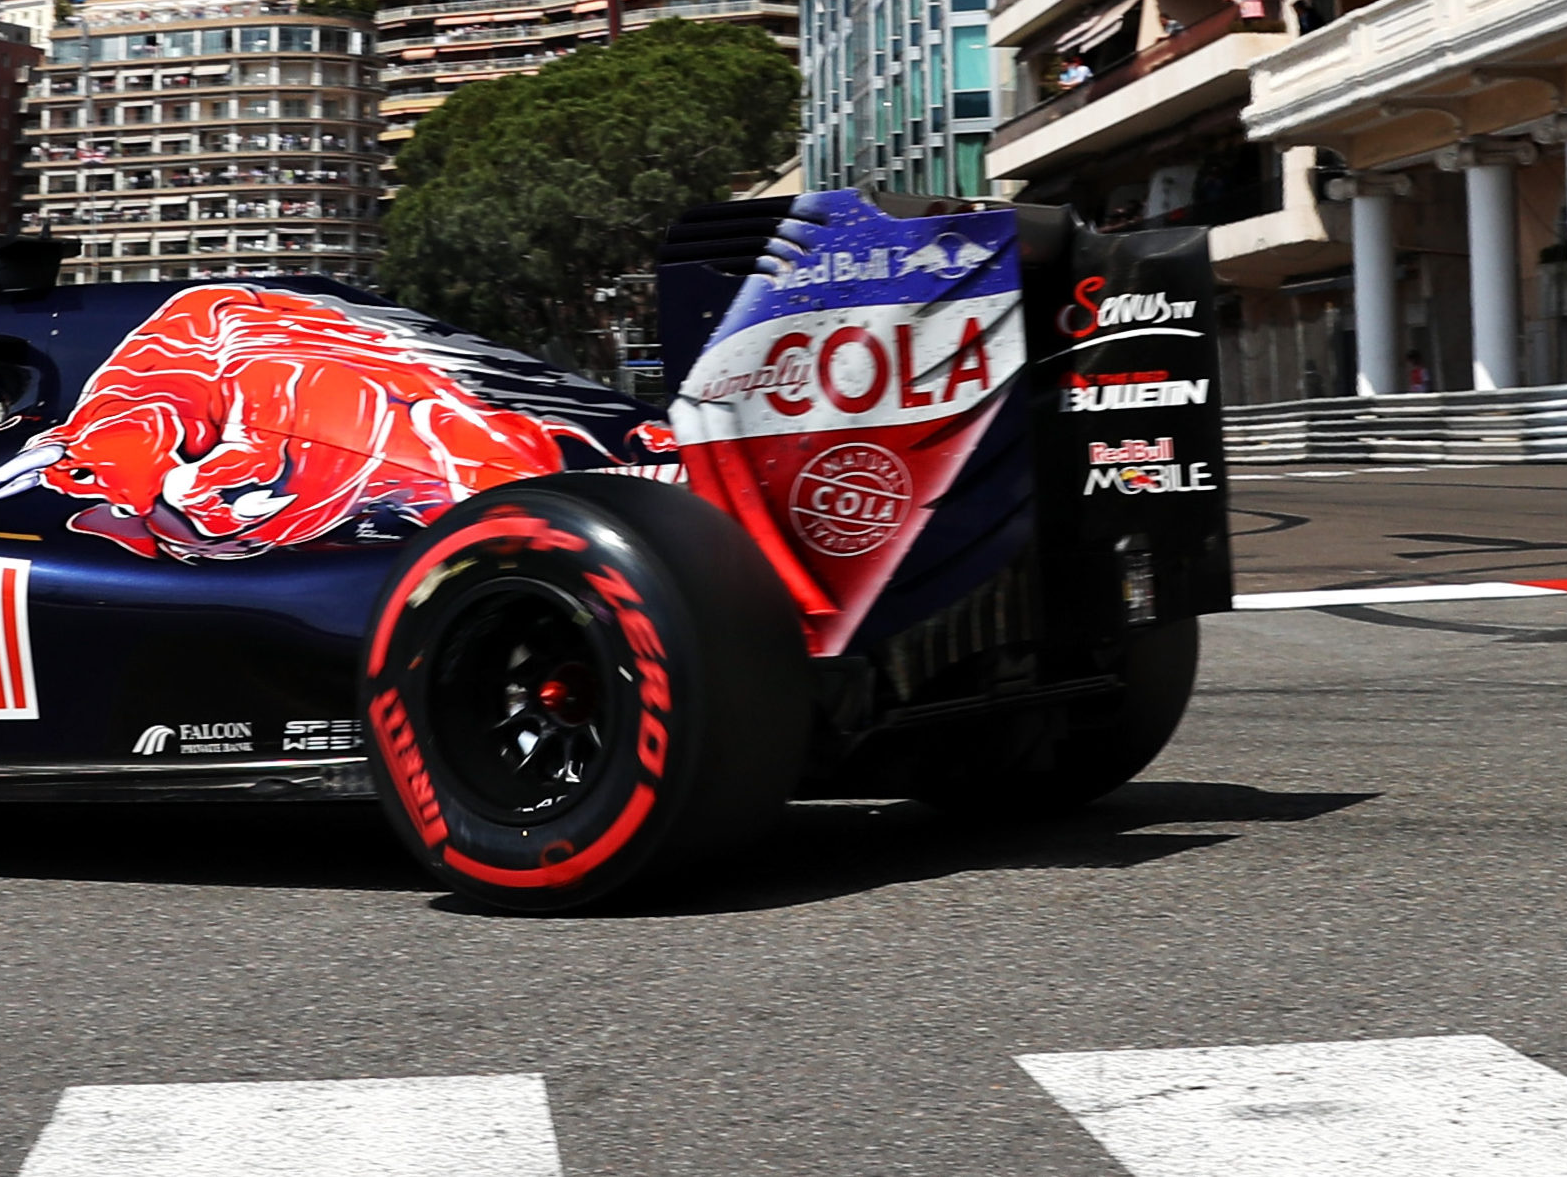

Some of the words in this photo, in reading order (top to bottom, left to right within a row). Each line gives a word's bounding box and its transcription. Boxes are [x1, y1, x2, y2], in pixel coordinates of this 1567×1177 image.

[832, 248, 889, 282] Bull
[764, 317, 990, 417] COLA
[1059, 379, 1209, 412] BULLETIN
[1130, 437, 1174, 463] Bull
[1084, 462, 1217, 496] MOBILE
[811, 486, 895, 521] COLA
[180, 722, 252, 741] FALCON
[368, 686, 449, 849] PIRELLI
